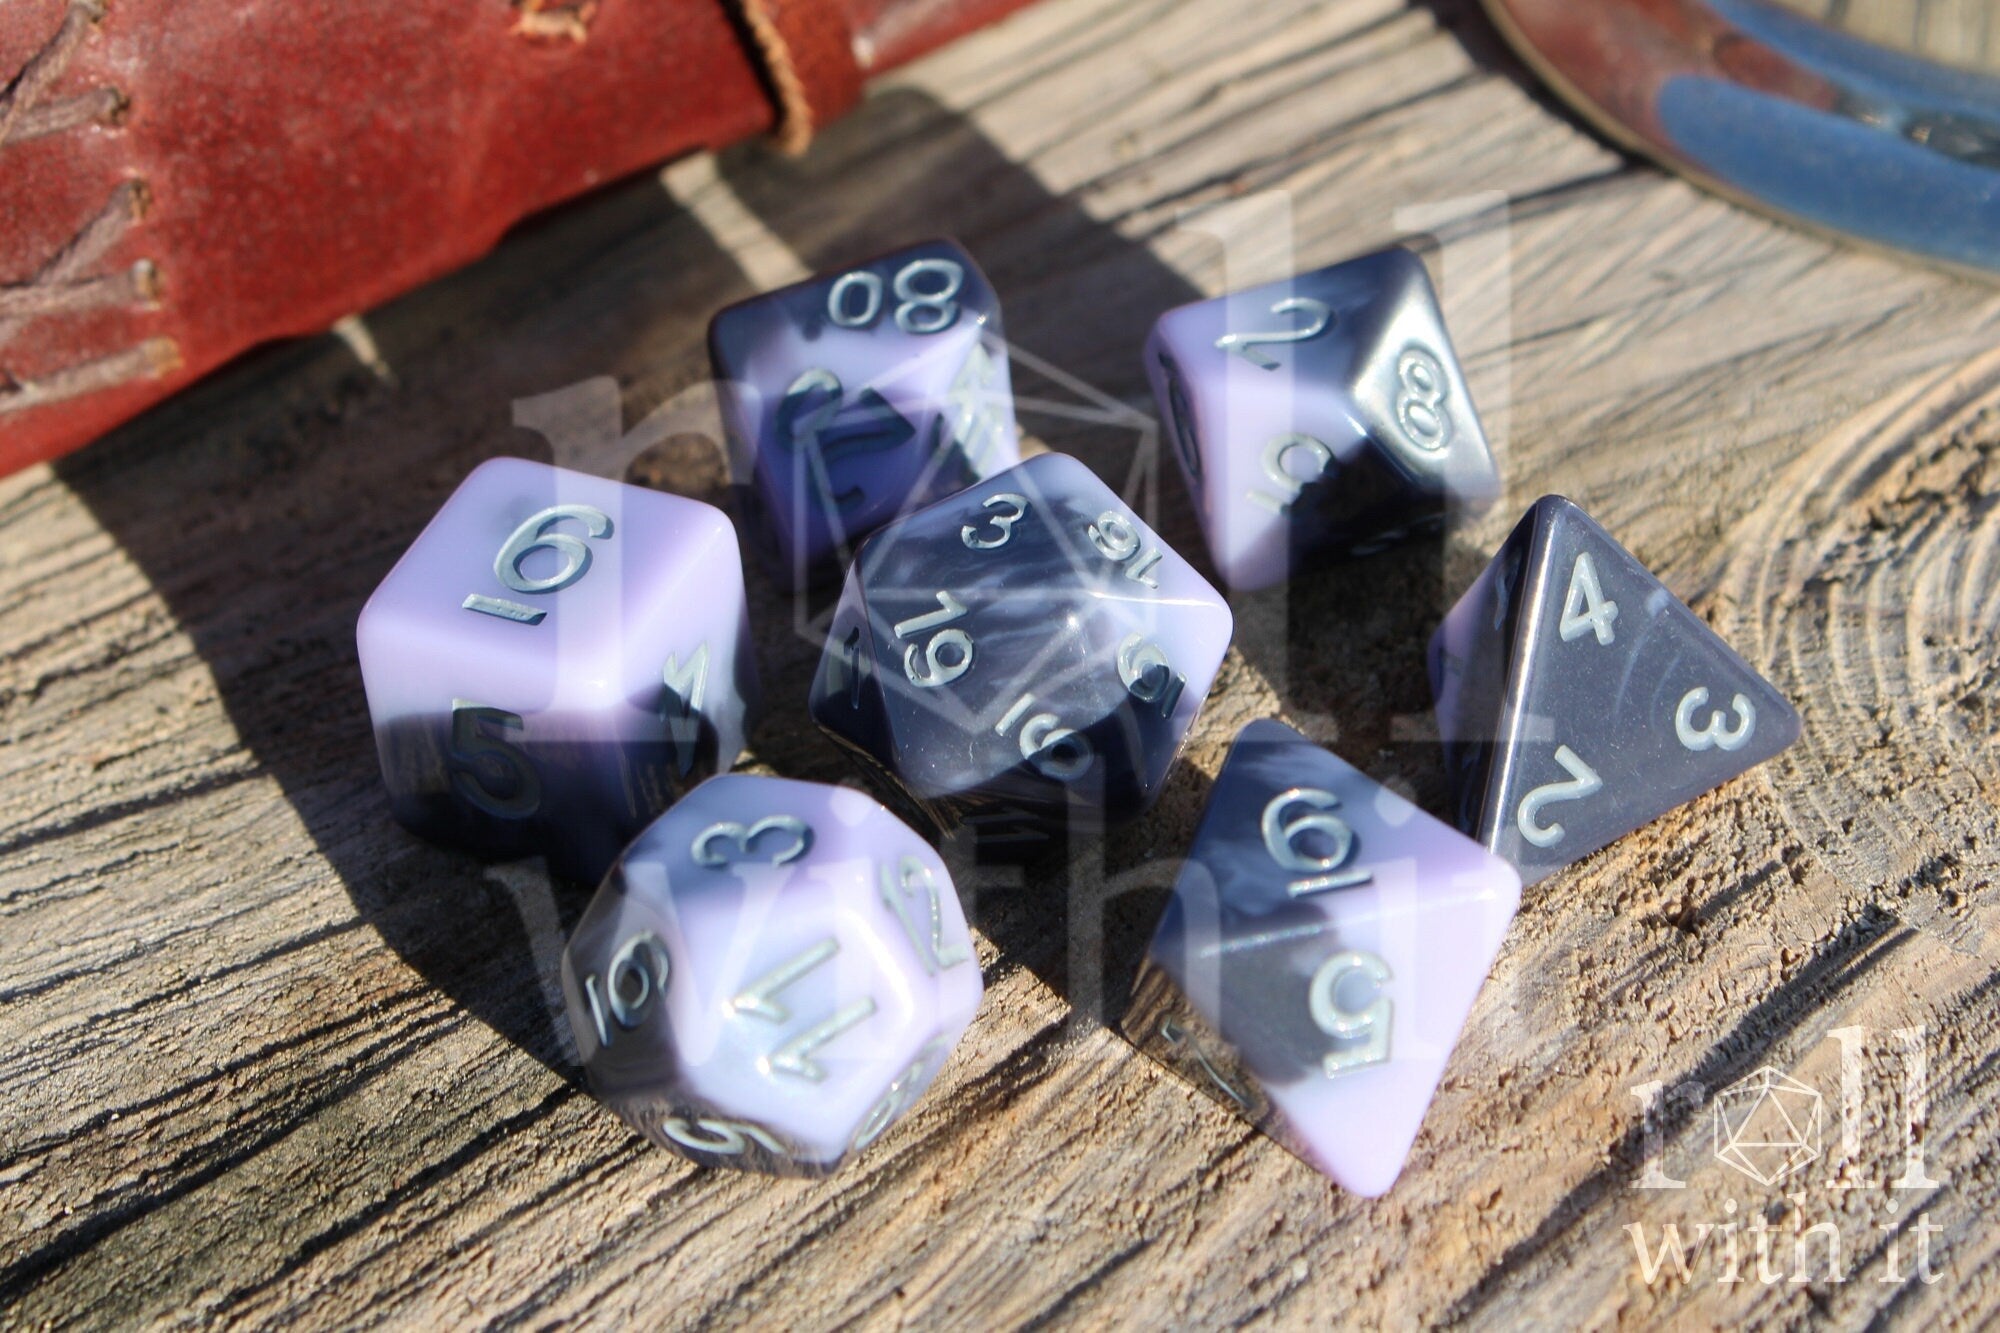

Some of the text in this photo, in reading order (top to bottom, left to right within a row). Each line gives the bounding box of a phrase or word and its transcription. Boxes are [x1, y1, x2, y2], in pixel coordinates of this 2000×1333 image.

[1213, 297, 1334, 373] 2
[1398, 345, 1451, 453] 8
[962, 493, 1029, 550] 3
[1559, 551, 1619, 646] 4
[1675, 686, 1757, 752] 3
[1517, 744, 1602, 848] 2
[690, 814, 816, 869] 3
[1308, 950, 1396, 1080] 5
